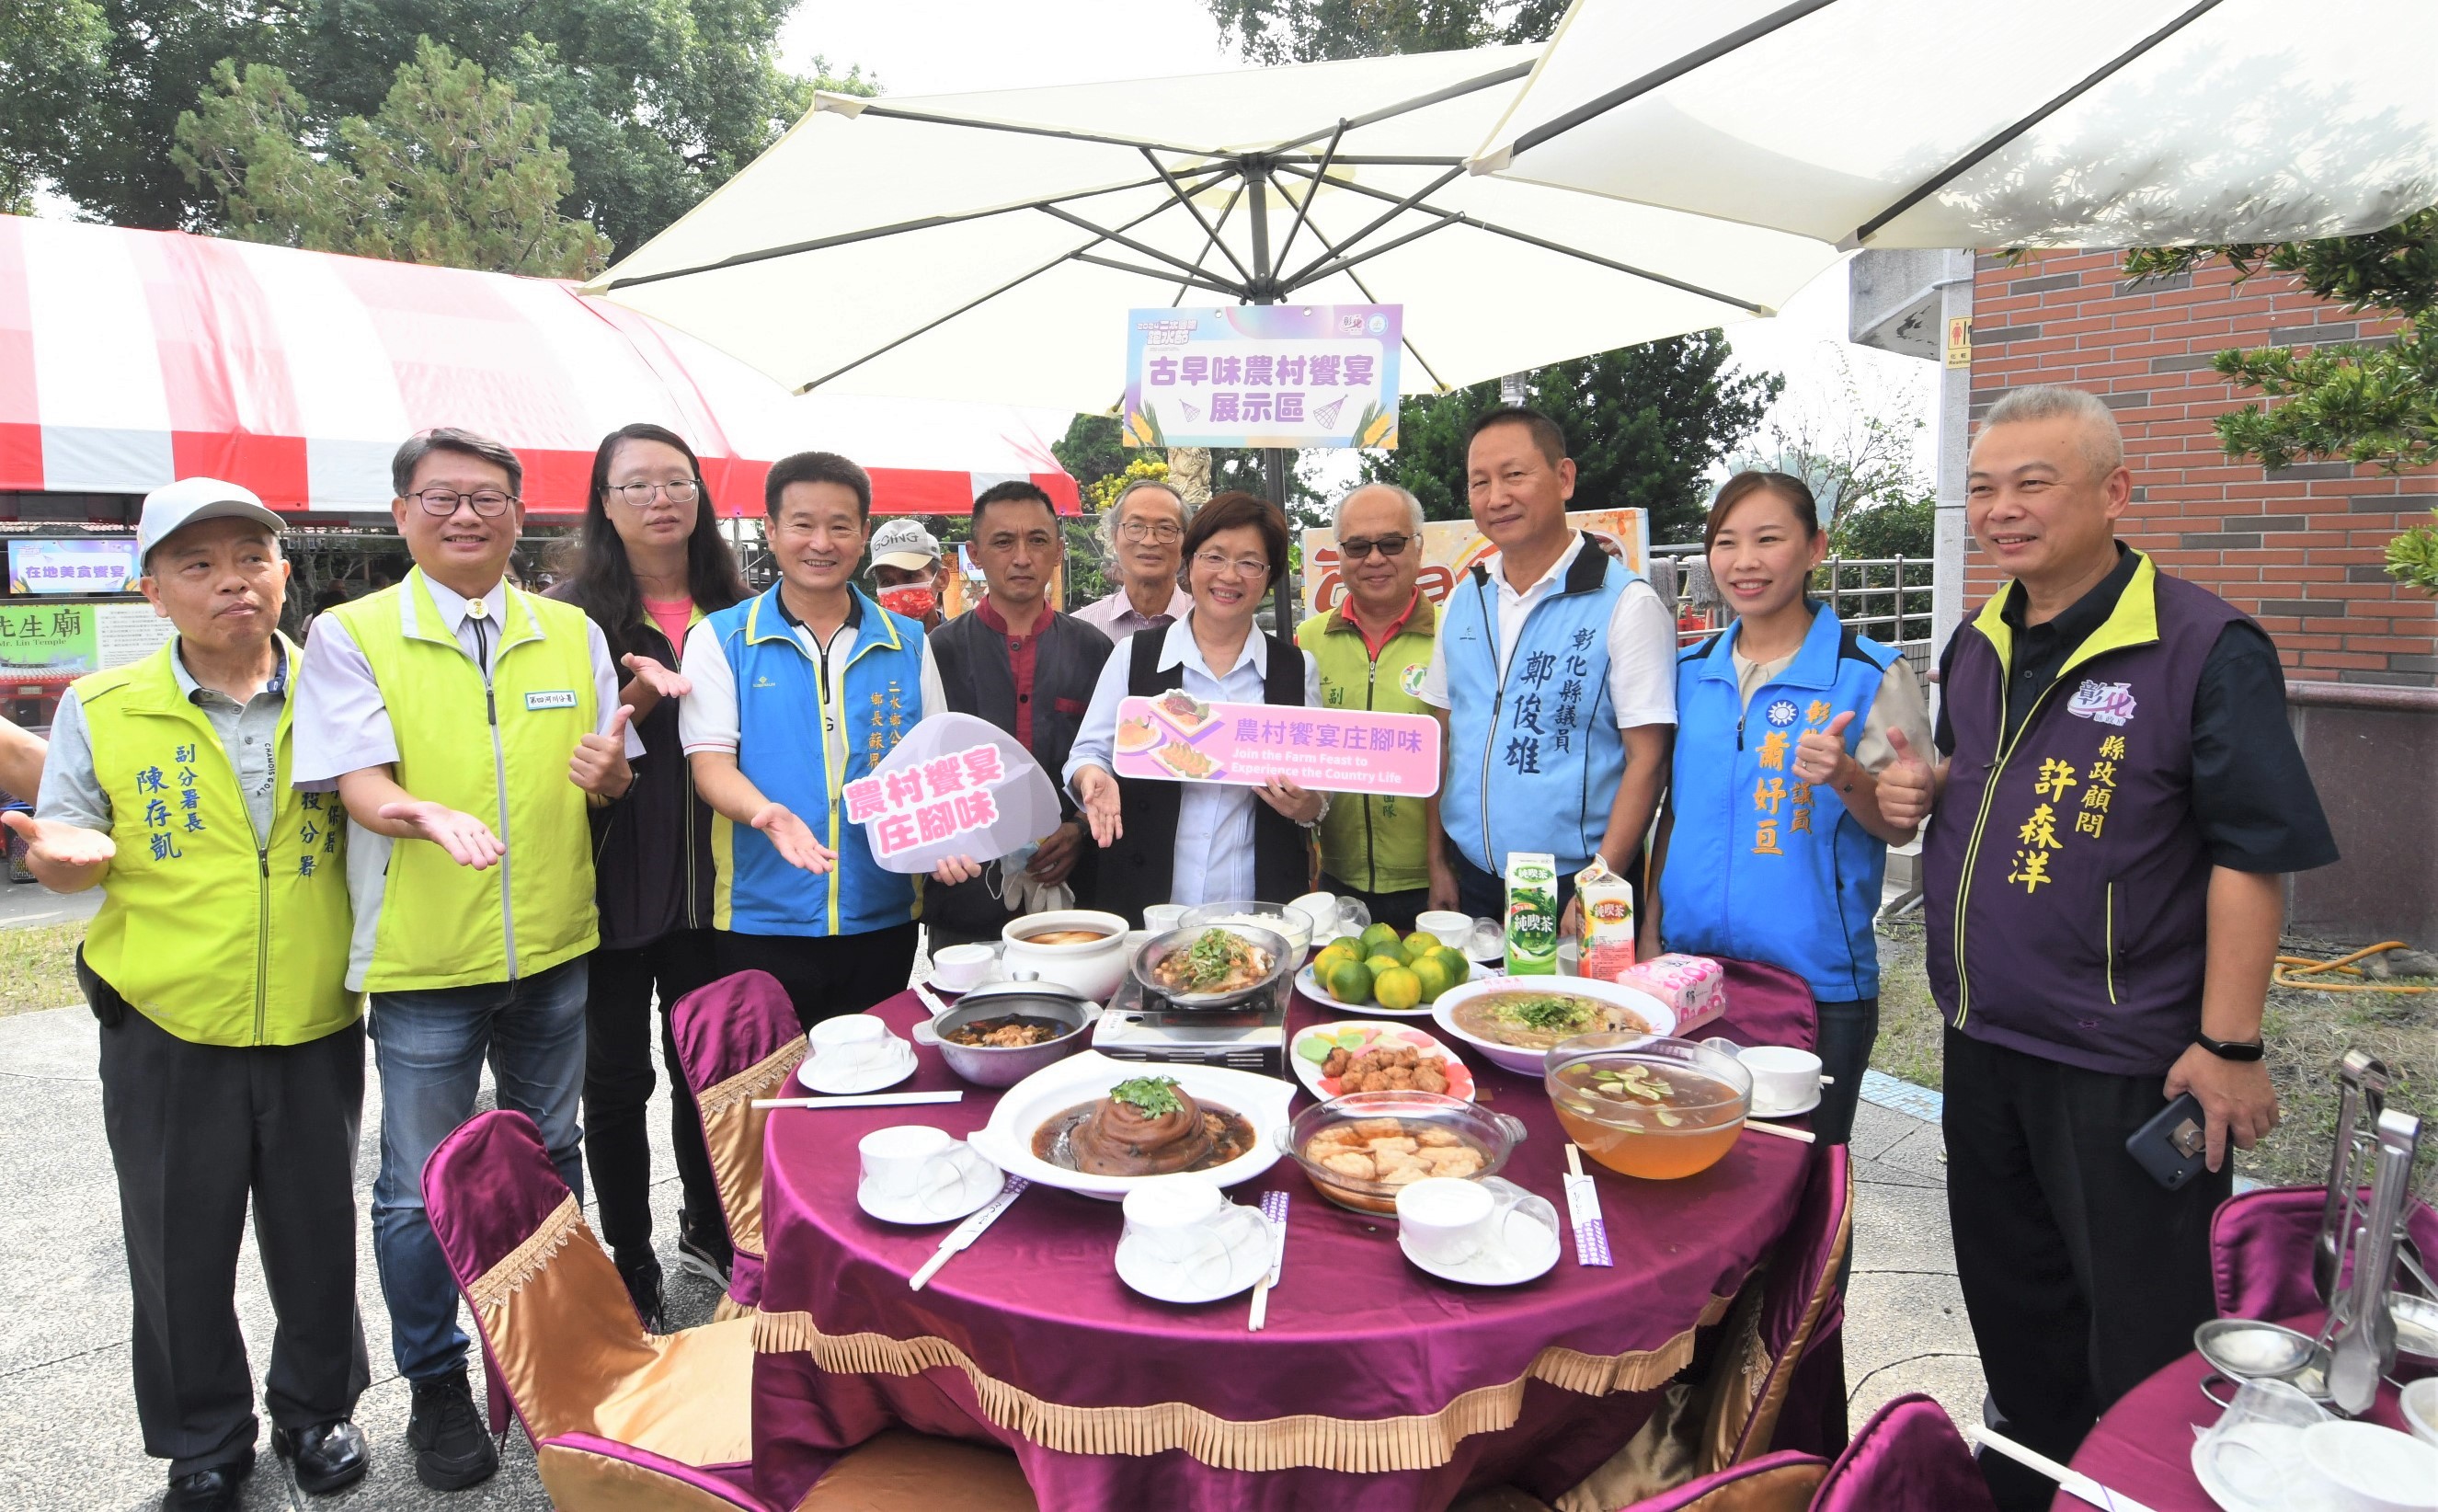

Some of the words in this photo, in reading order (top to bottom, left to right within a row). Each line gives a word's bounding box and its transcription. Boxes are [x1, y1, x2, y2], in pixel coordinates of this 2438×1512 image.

[1150, 354, 1374, 386] 古早味農村饗宴
[1209, 392, 1306, 423] 展示區
[26, 565, 124, 578] 在地美食饗宴
[1328, 686, 1345, 704] 副
[1553, 627, 1597, 754] 彰化縣議員
[887, 681, 902, 750] 二水鄉公
[1504, 650, 1557, 775] 鄭俊雄
[1234, 717, 1423, 753] 農村饗宴庄腳味
[264, 742, 275, 775] CHAMOIS
[1230, 762, 1299, 777] Experience
[1302, 764, 1322, 778] the
[1325, 768, 1375, 784] Country
[1379, 771, 1402, 784] Life
[1231, 748, 1259, 760] Join
[1261, 750, 1282, 762] the
[1285, 750, 1316, 763] Farm
[1320, 752, 1352, 766] Feast
[1356, 756, 1368, 767] to
[175, 743, 206, 832] 副分署長
[256, 776, 274, 796] GOLF
[845, 746, 1002, 821] 農村饗宴
[2075, 735, 2125, 839] 縣政顧問
[136, 765, 182, 861] 陳存凱
[877, 790, 996, 854] 庄腳味
[2008, 757, 2077, 894] 許森洋
[1518, 868, 1549, 879] 純喫茶
[1514, 913, 1554, 933] 純喫茶
[1595, 903, 1624, 918] 純喫茶
